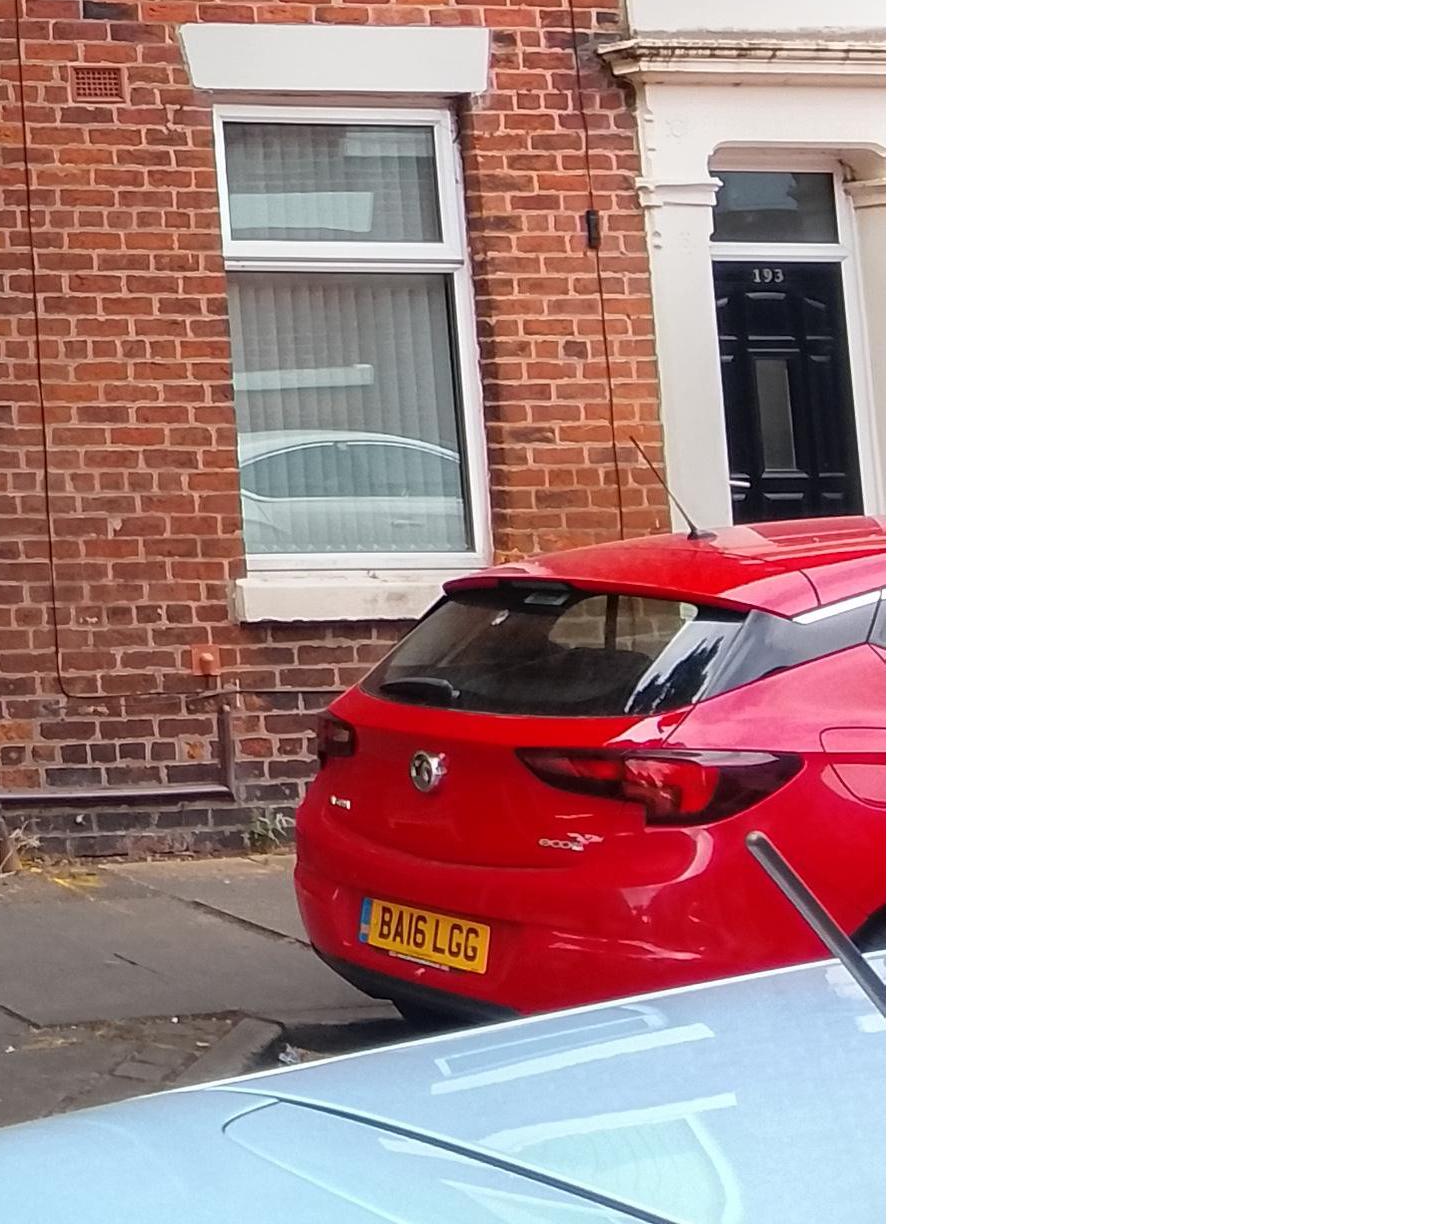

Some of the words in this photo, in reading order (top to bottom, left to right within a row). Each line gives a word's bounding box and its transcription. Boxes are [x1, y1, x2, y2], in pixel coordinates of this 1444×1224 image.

[752, 268, 784, 283] 193
[378, 906, 428, 949] BA16
[432, 918, 480, 962] LGG
